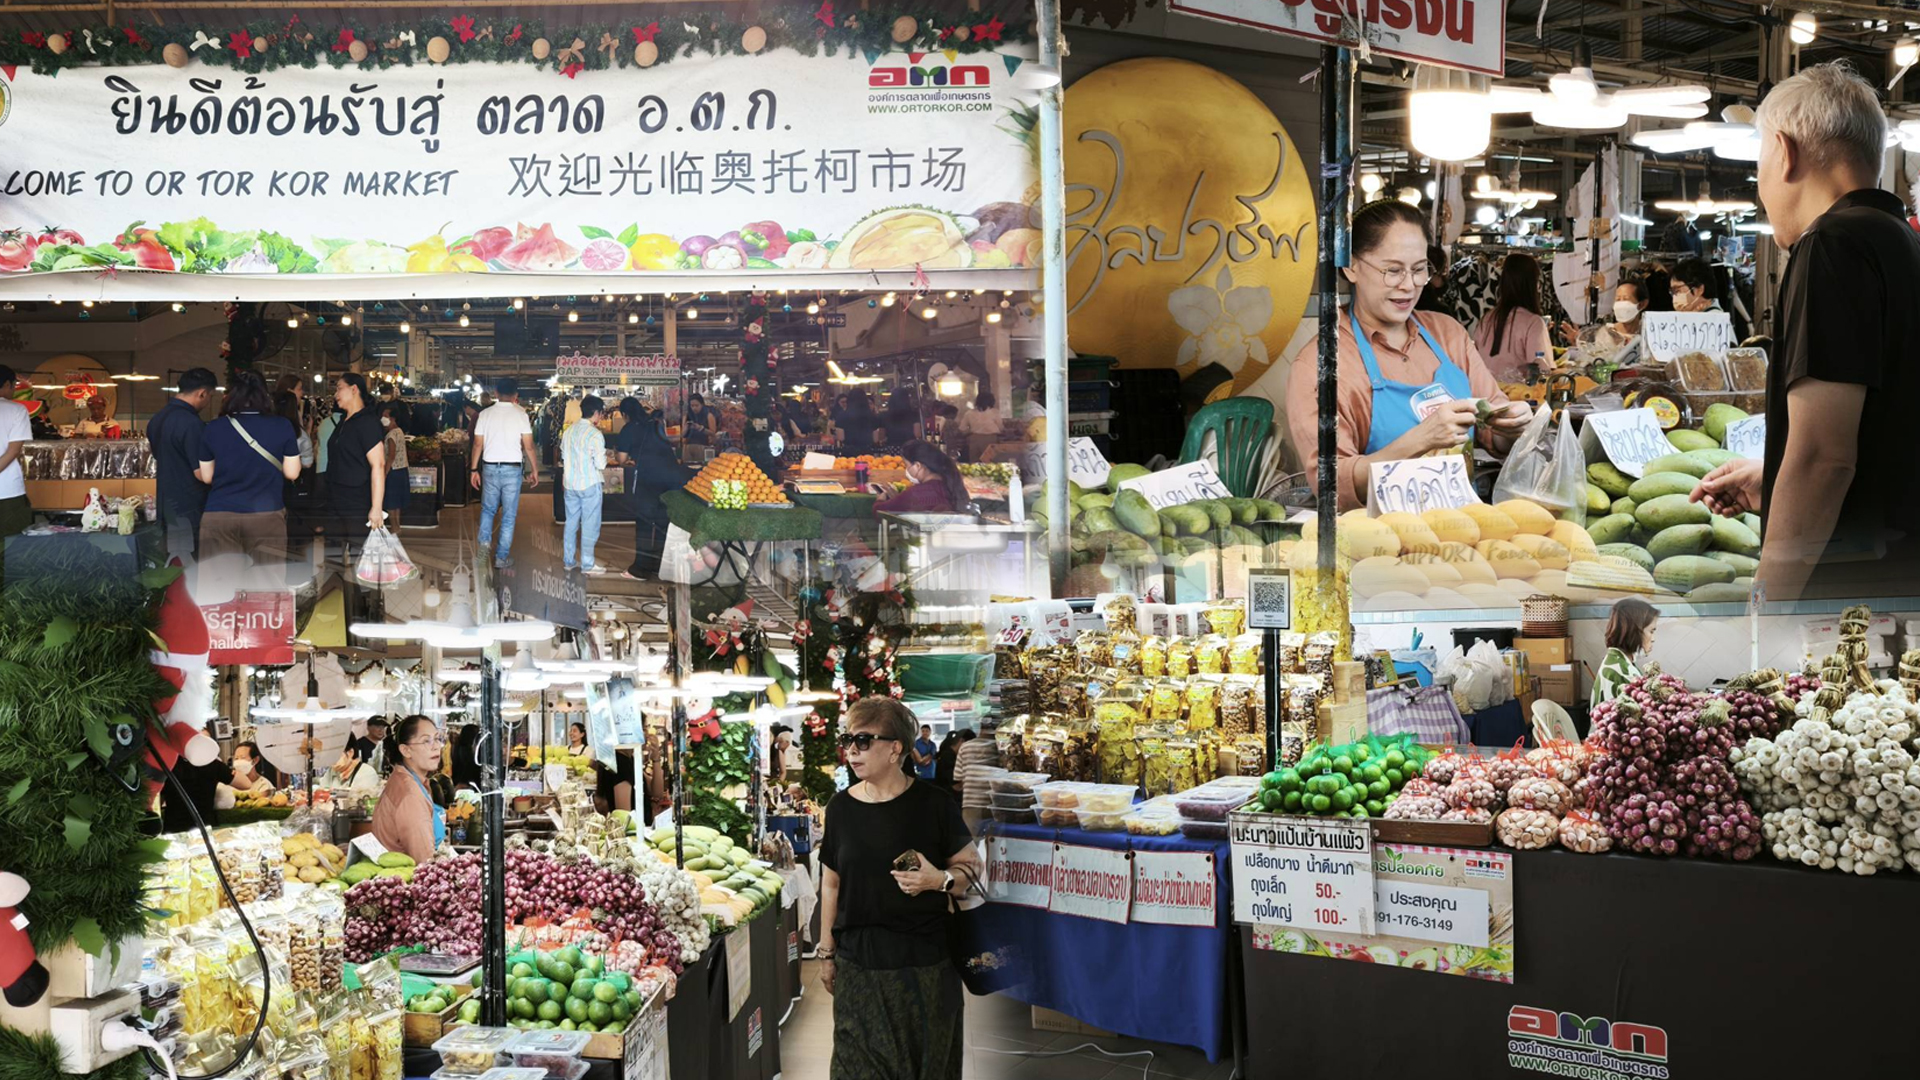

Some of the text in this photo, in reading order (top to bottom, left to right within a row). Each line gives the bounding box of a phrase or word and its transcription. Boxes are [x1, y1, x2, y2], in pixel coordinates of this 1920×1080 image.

[868, 89, 992, 102] องค์การตลาดเพื่อเกษตรกร
[104, 75, 793, 153] ยินดีต้อนรับสู่ ตลาด อ.ต.ก.
[867, 102, 993, 114] WWW.ORTORKOR.COM
[0, 169, 460, 197] COME TO OR TOR KOR MARKET
[508, 146, 967, 198] 欢迎光临奥托柯市场
[557, 367, 581, 376] GAP
[1393, 541, 1476, 566] SUPPORT
[204, 606, 284, 630] รีสะเกษ
[209, 638, 249, 650] hallot
[1235, 826, 1365, 851] มะนาวแป้นบ้านแพ้ว
[1244, 853, 1355, 876] เปลือกบาง น้ำดีมาก
[1250, 876, 1341, 900] ถุงเล็ก 50.-
[1252, 898, 1348, 926] ถุงใหญ่ 100.-
[1390, 889, 1457, 912] ประสงคุณ
[1508, 1040, 1669, 1079] องค์การตลาดเพื่อเกษตรกร
